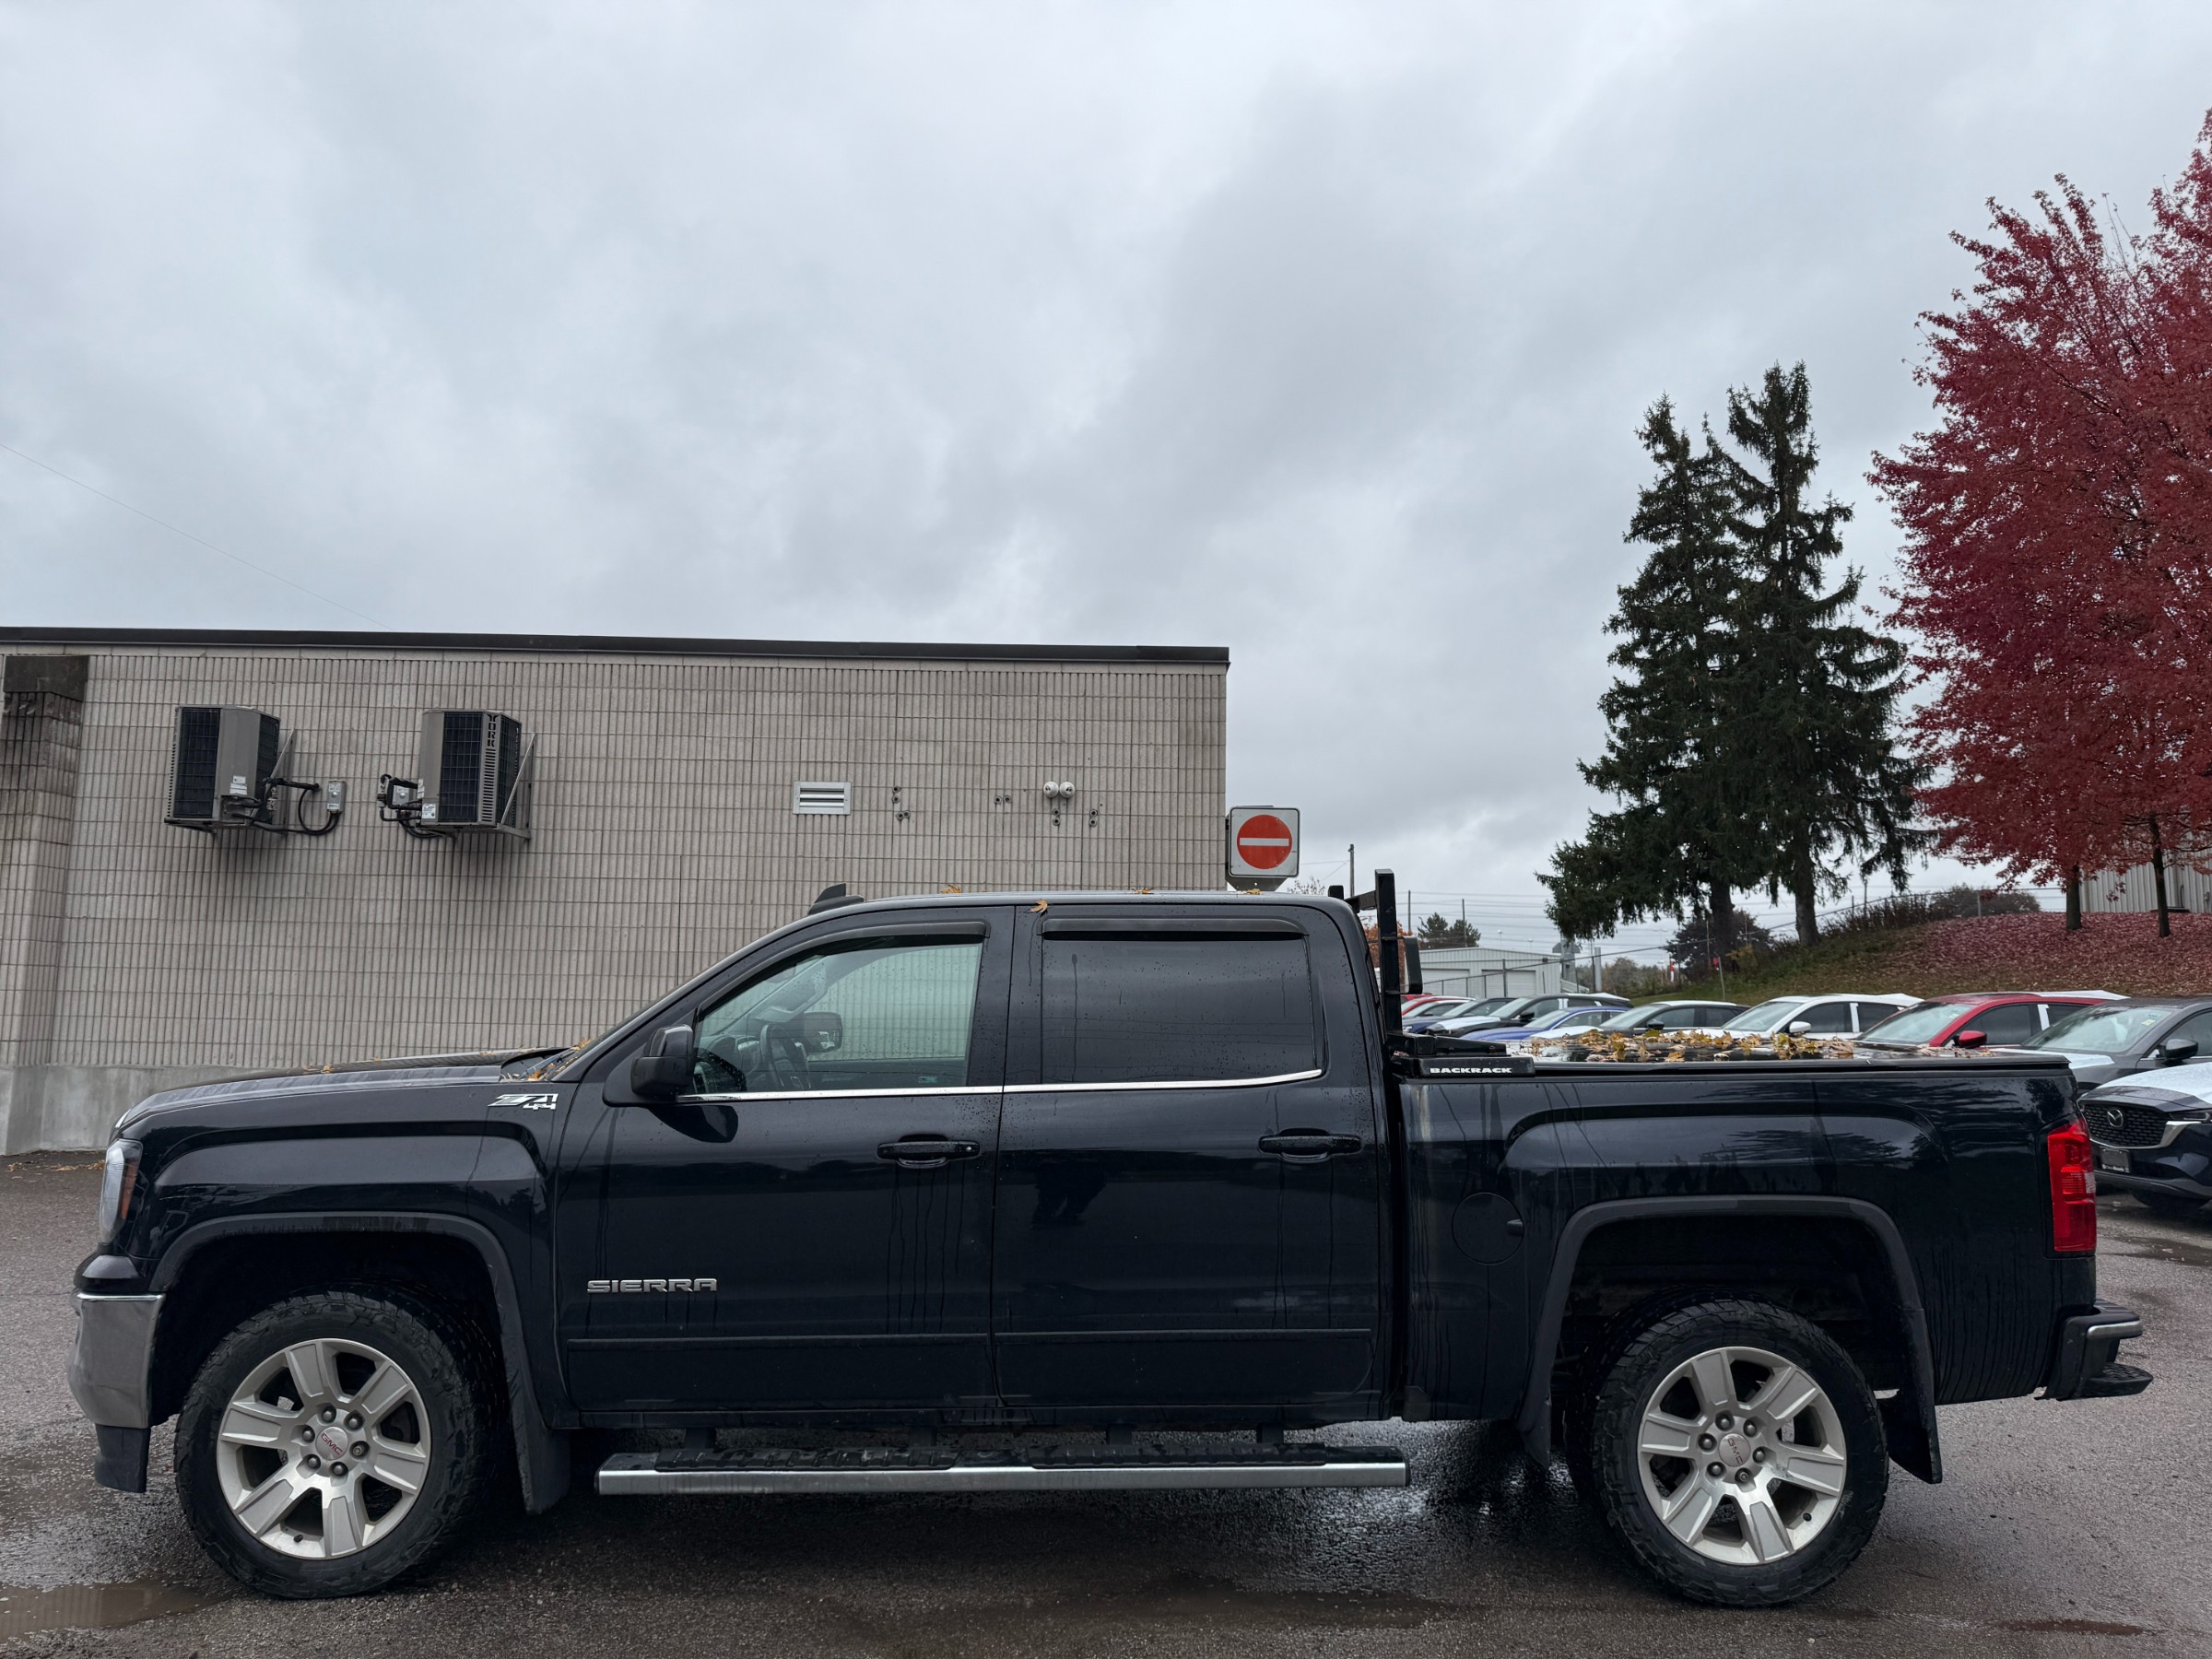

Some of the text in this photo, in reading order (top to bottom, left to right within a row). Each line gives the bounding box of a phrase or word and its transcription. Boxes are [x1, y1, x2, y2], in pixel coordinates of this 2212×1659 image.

[487, 714, 499, 747] YORK
[587, 1278, 717, 1293] SIERRA
[321, 1432, 344, 1455] GMC
[1727, 1437, 1744, 1465] GMC
